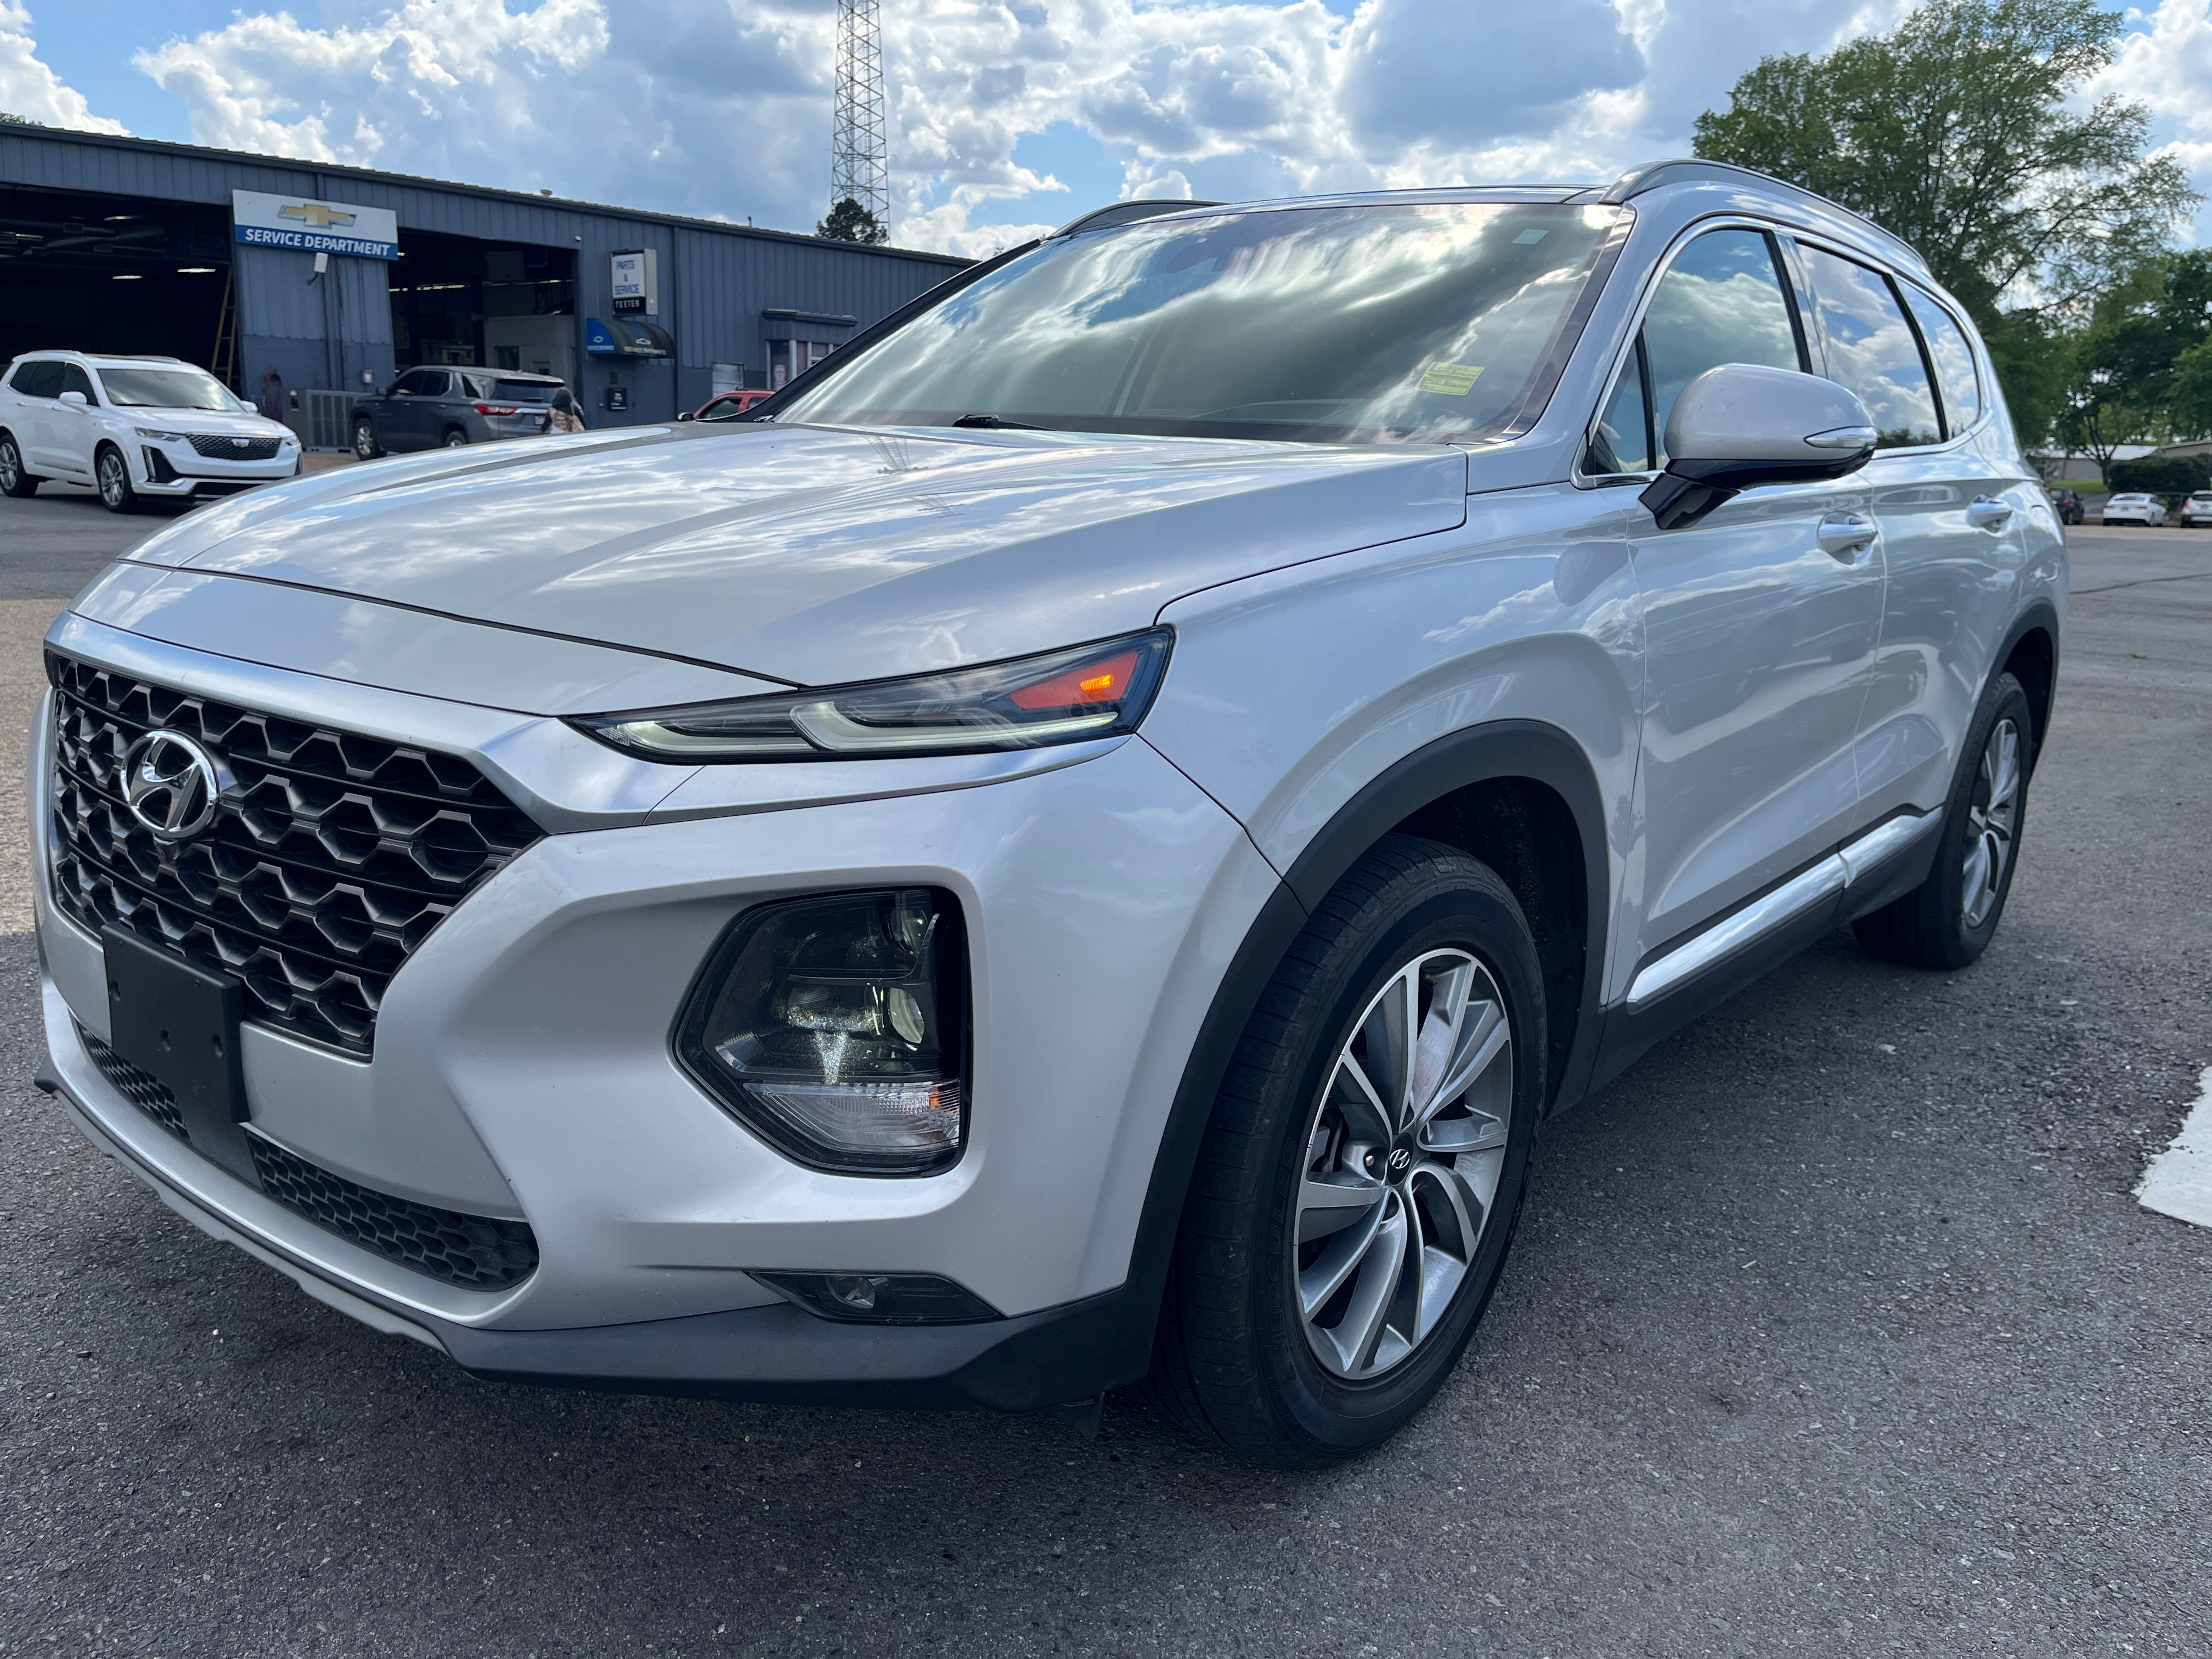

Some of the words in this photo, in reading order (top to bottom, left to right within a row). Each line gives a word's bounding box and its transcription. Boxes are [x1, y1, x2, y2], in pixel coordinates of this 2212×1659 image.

[245, 228, 302, 246] SERVICE
[304, 236, 391, 256] DEPARTMENT
[1267, 1136, 1297, 1357] HERCULES
